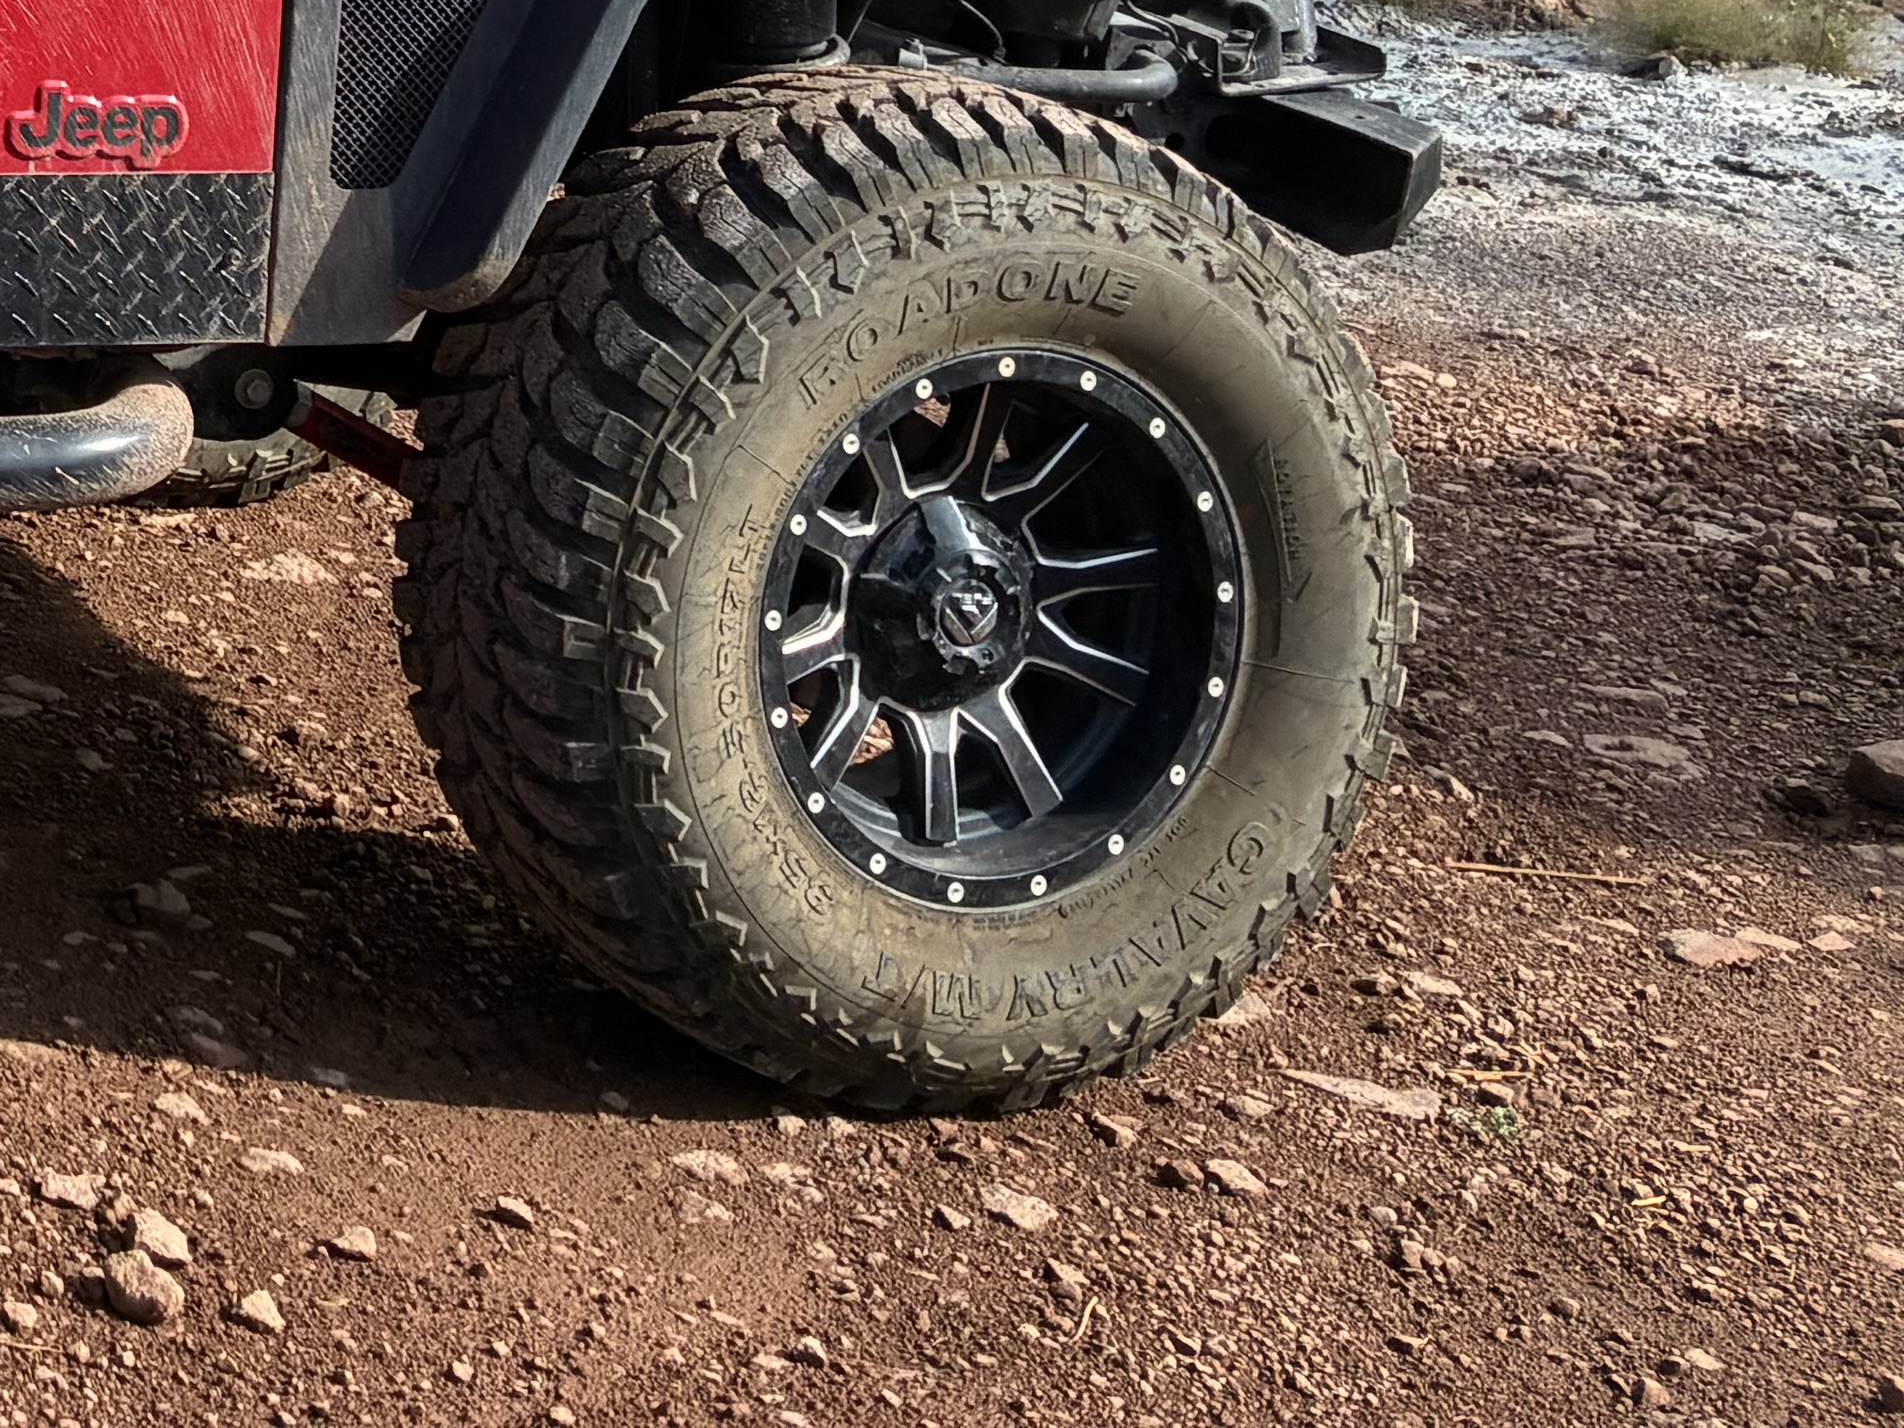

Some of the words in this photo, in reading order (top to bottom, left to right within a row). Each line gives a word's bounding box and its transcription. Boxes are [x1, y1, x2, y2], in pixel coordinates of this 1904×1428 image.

[19, 92, 180, 159] Jeep
[796, 256, 1142, 406] ROADONE
[1005, 820, 1273, 1022] CAVALRY
[861, 950, 984, 1021] M/T
